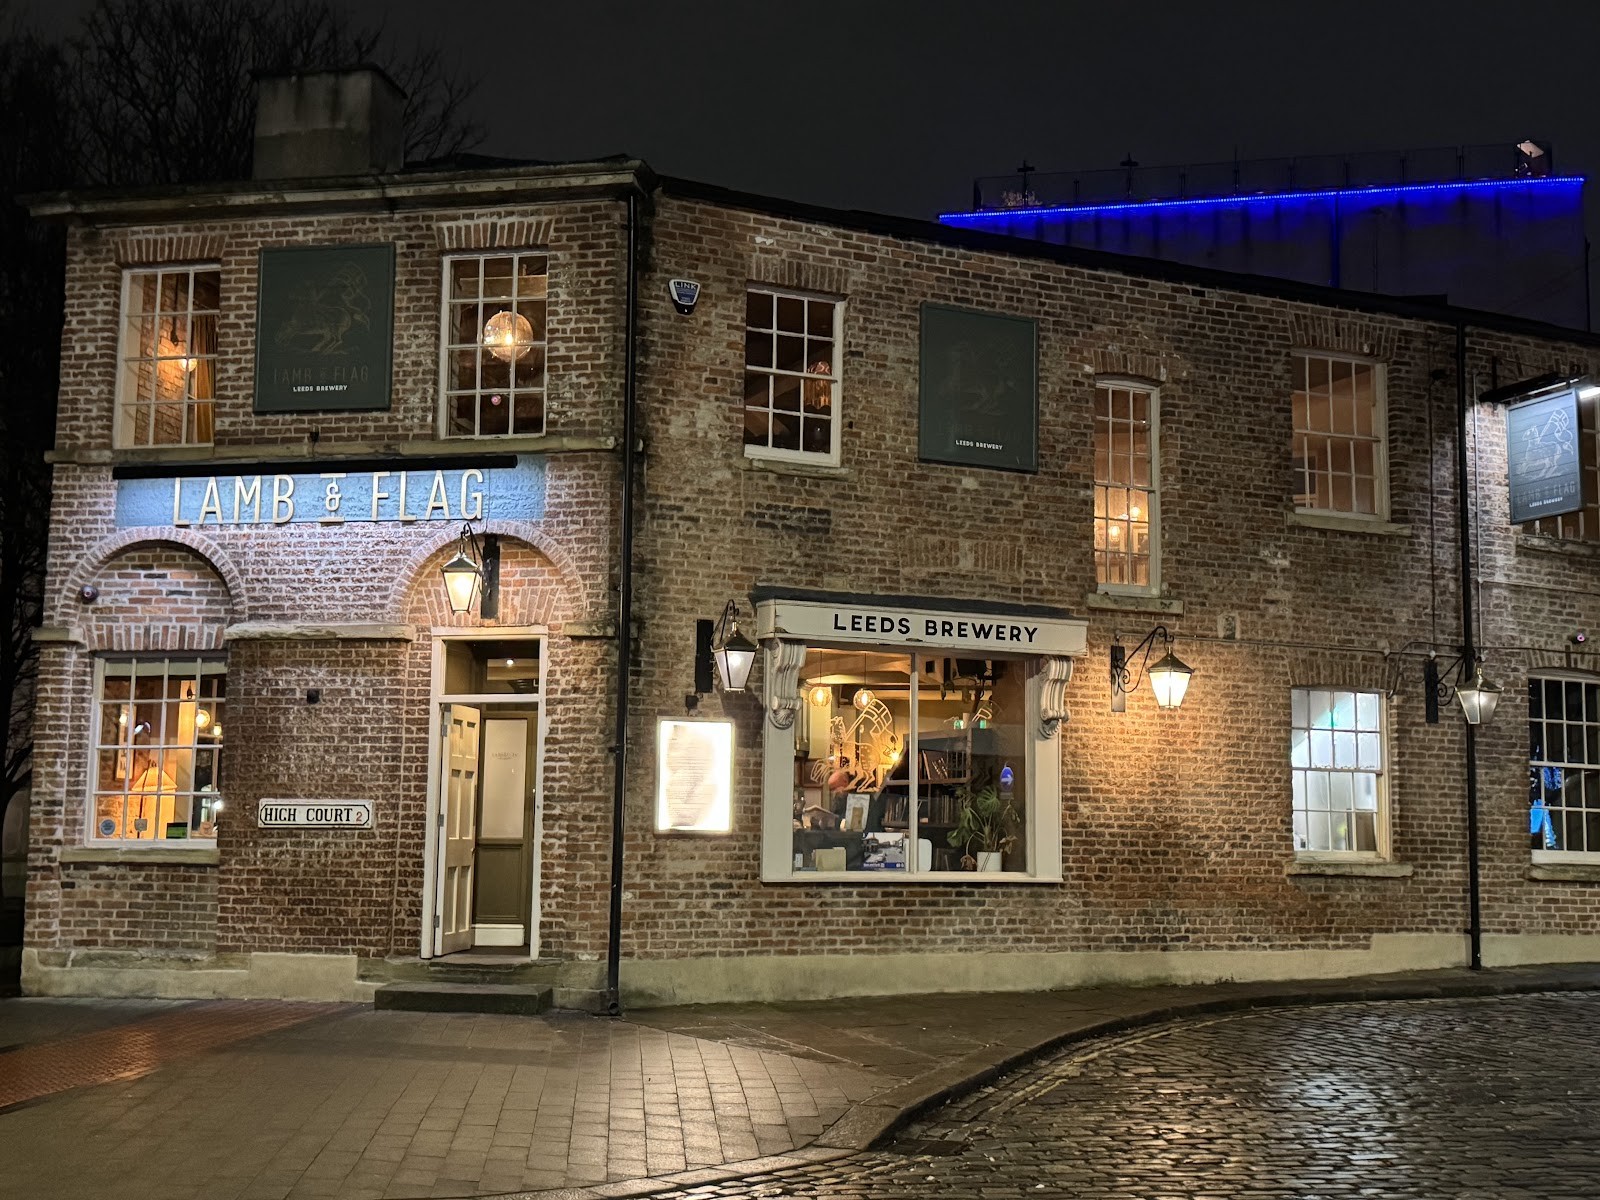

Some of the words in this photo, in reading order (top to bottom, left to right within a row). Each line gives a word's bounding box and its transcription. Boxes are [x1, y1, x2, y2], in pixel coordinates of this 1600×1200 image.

[675, 281, 697, 289] LINK
[334, 364, 369, 384] FLAG
[292, 385, 314, 393] LEEDS
[316, 384, 348, 392] BREWERY
[955, 439, 974, 447] LEEDS
[976, 441, 1003, 450] BREWERY
[1553, 481, 1576, 495] FLAG
[173, 473, 295, 526] LAMB
[371, 468, 484, 521] FLAG
[833, 613, 911, 635] LEEDS
[925, 619, 1038, 643] BREWERY
[264, 807, 297, 822] HIGH
[306, 808, 353, 822] COURT
[355, 811, 363, 822] 2
